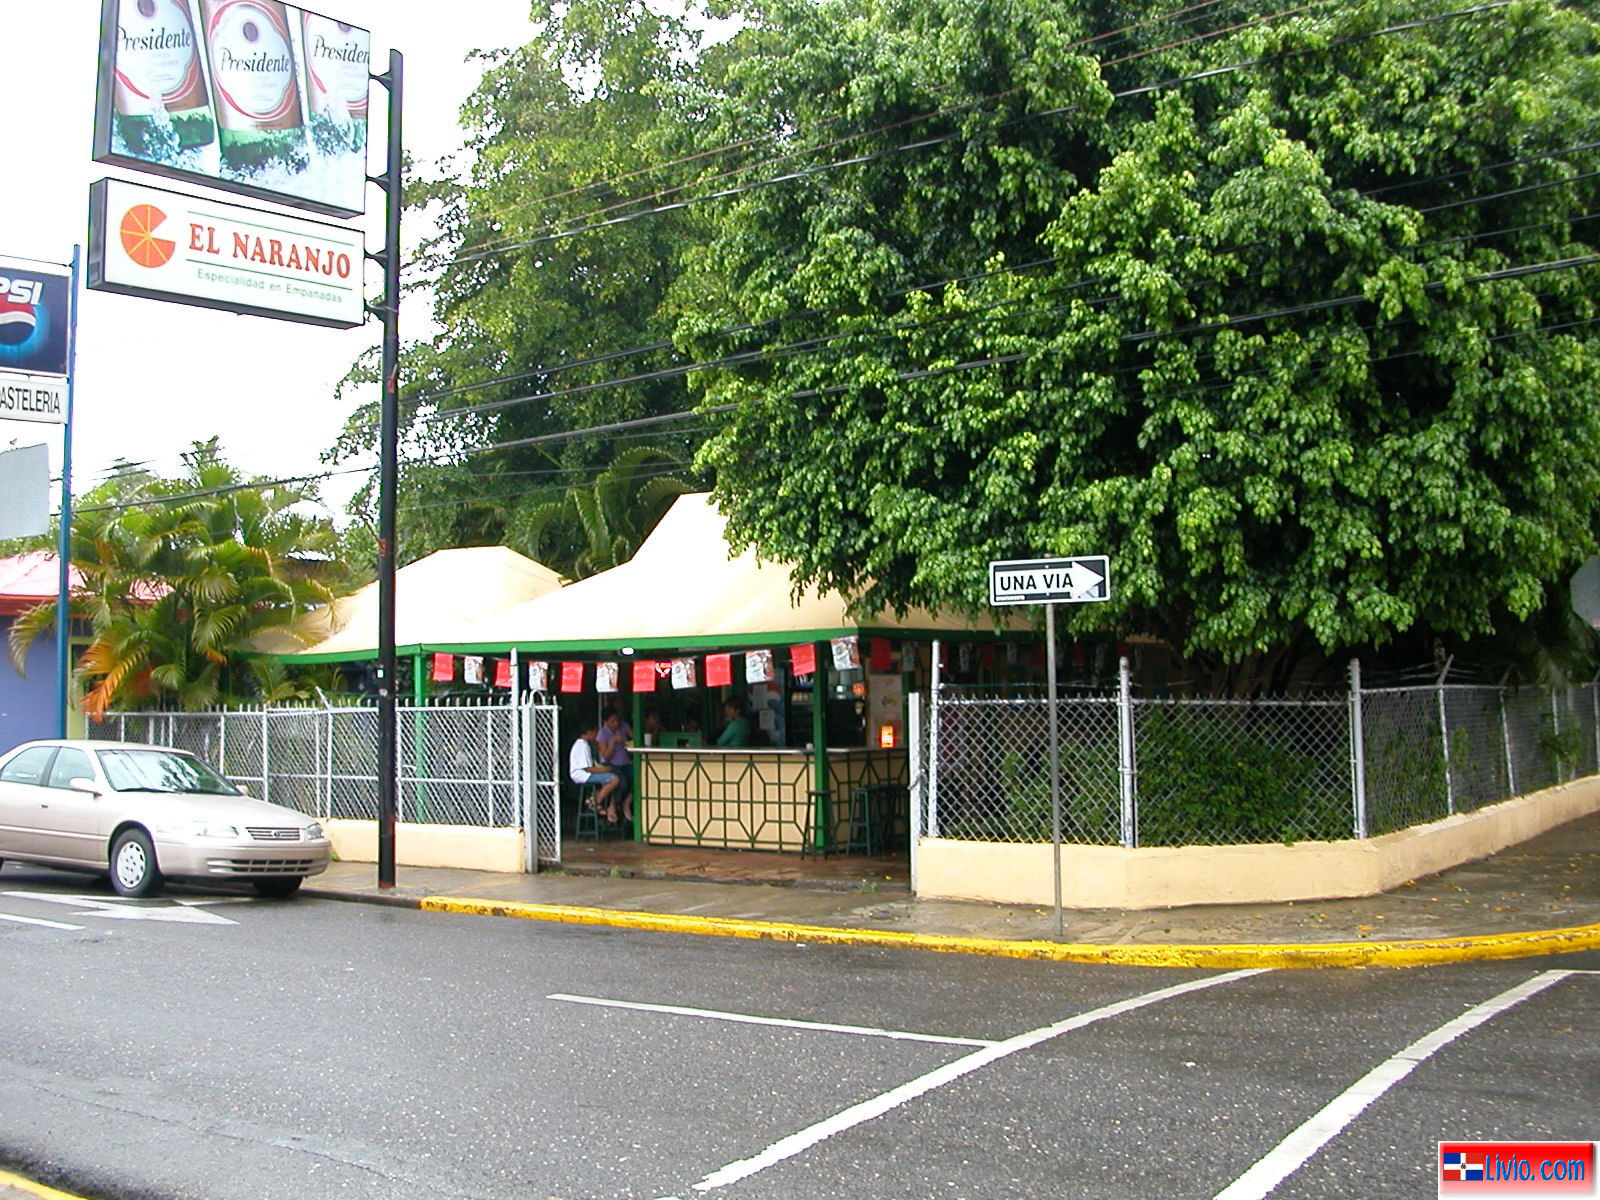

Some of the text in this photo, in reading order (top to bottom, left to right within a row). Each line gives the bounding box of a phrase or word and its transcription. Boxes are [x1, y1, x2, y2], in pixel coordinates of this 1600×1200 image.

[220, 47, 290, 72] Presidente
[189, 223, 350, 279] EL NARANJO
[197, 268, 342, 303] Especialidad en Empanadas
[0, 386, 61, 413] ASTELERIA
[1000, 572, 1074, 591] UNA VIA
